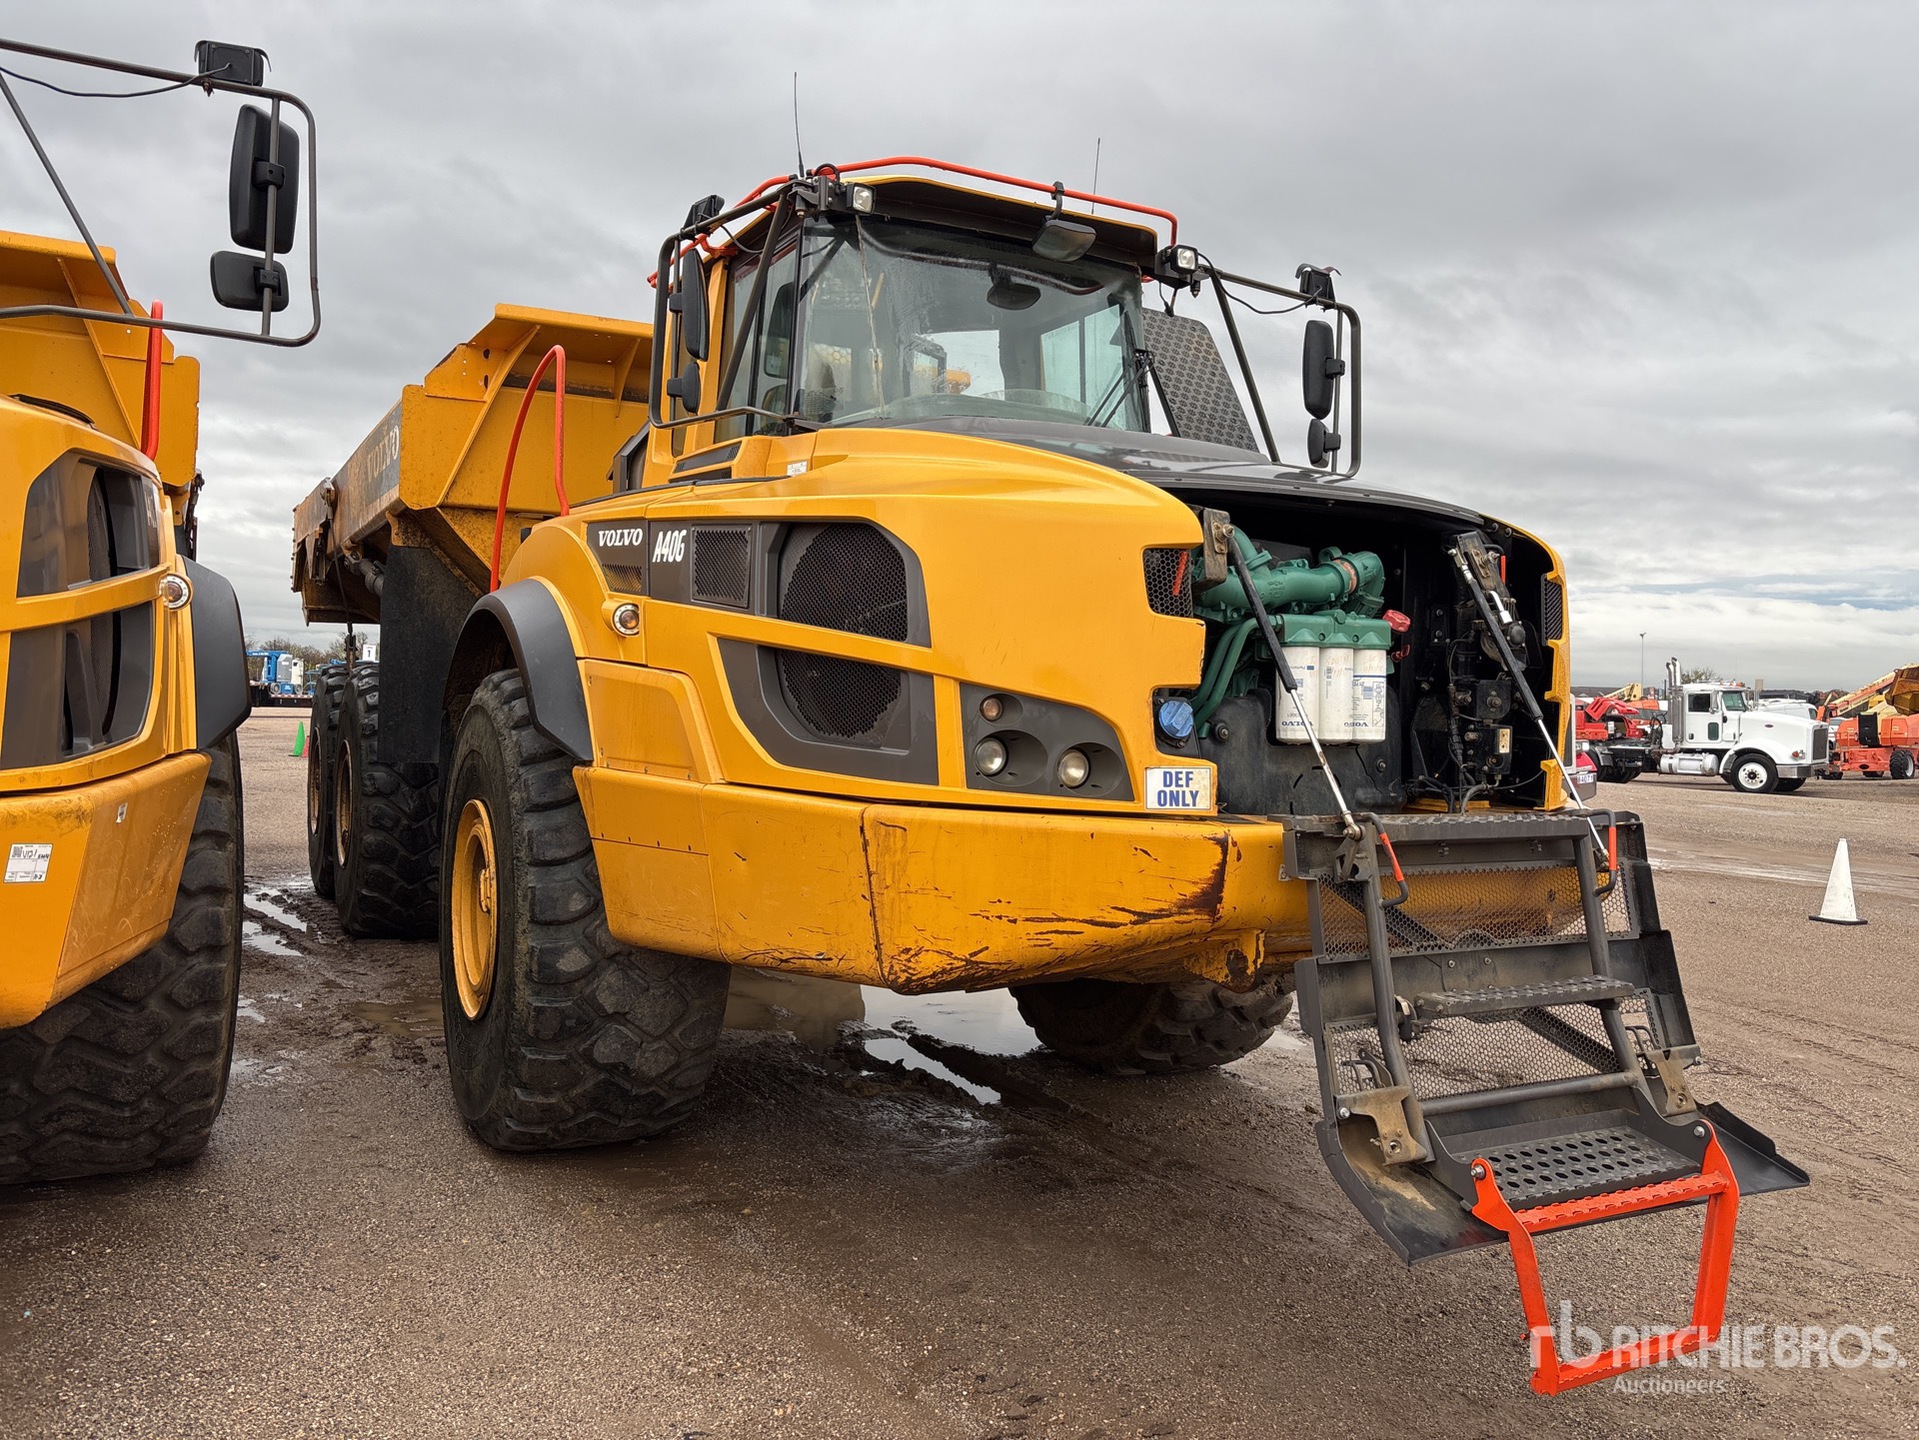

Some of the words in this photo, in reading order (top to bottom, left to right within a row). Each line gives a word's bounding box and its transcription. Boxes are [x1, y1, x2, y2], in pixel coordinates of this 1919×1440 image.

[598, 528, 643, 547] VOLVO
[652, 529, 687, 563] A40G
[1163, 771, 1194, 788] DEF
[1157, 789, 1199, 807] ONLY
